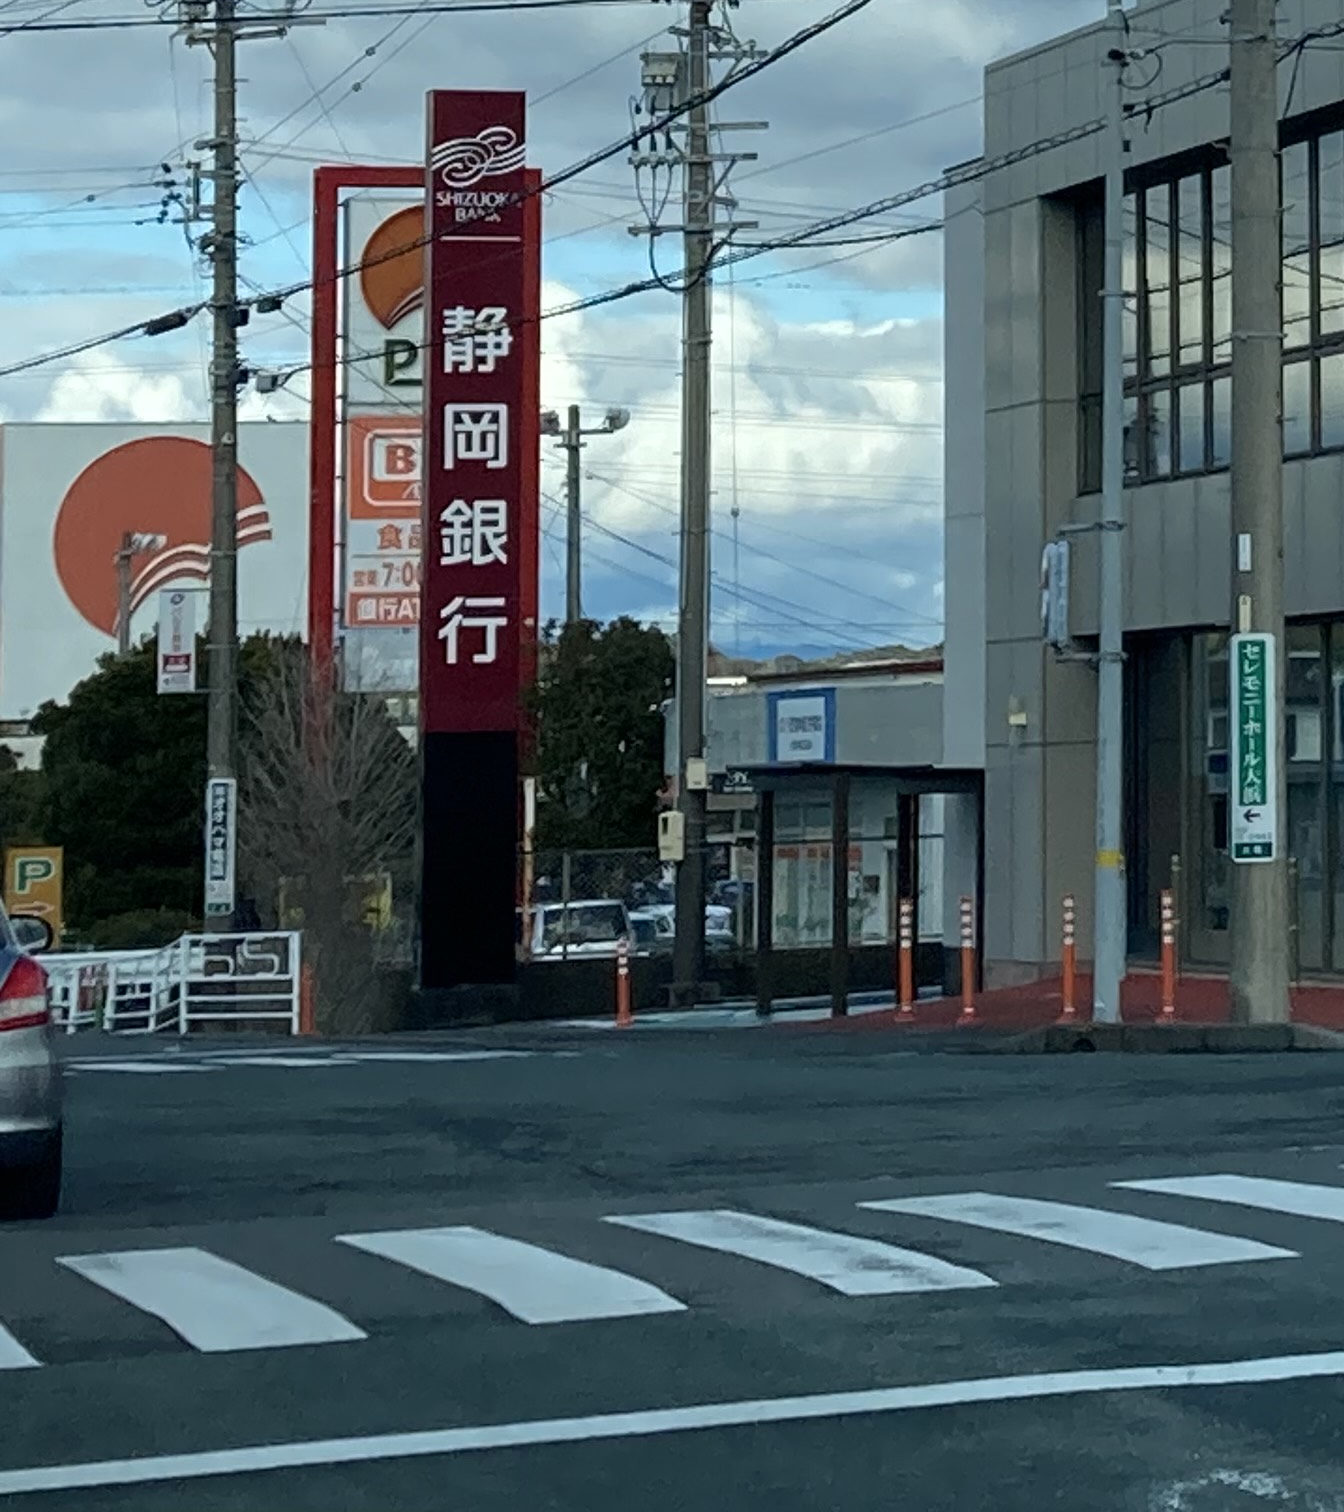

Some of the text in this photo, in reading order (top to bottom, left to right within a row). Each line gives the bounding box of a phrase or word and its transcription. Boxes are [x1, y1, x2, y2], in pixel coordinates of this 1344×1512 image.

[435, 192, 522, 207] SHIZUOKA
[438, 306, 513, 665] 静岡銀行
[15, 857, 55, 894] P
